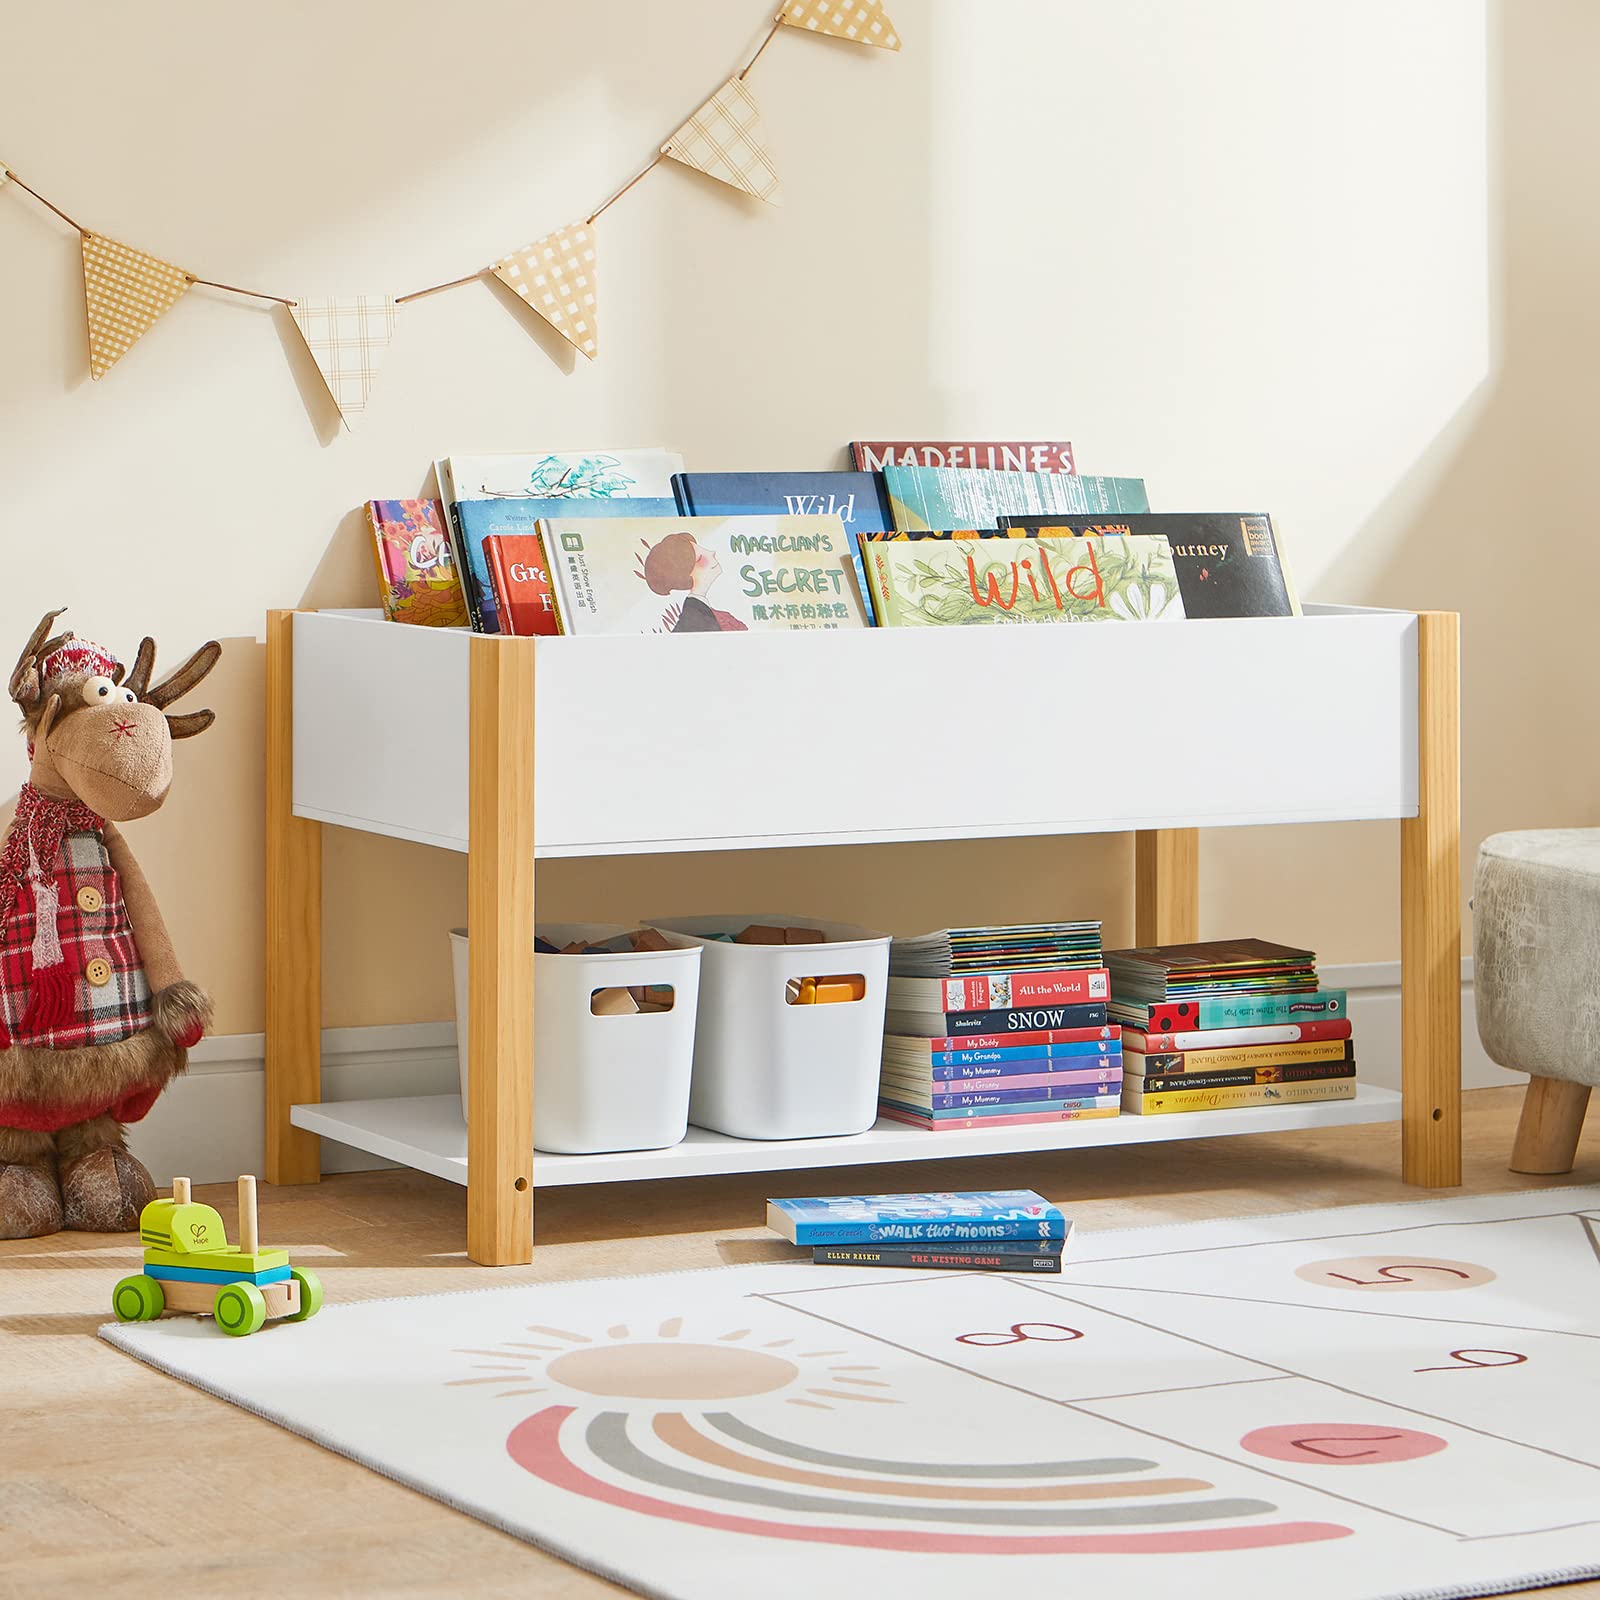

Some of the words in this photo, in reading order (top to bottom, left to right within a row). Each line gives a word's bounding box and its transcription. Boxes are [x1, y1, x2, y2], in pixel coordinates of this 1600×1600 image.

[783, 494, 856, 523] Wild
[489, 523, 514, 531] Carole
[730, 533, 833, 556] MAGICIAN'S
[581, 568, 590, 587] Show
[740, 564, 844, 597] SECRET
[585, 589, 597, 613] English
[752, 602, 849, 621] 魔术师的秘密
[1019, 986, 1035, 996] All
[1037, 984, 1052, 994] the
[1053, 983, 1081, 994] World
[1224, 1008, 1237, 1016] Pigs
[1256, 1006, 1274, 1014] Three
[1007, 1009, 1065, 1030] SNOW
[967, 1039, 978, 1048] My
[979, 1039, 999, 1047] Daddy
[962, 1053, 973, 1062] My
[974, 1052, 1001, 1061] Grandpa
[962, 1068, 974, 1077] My
[975, 1067, 1001, 1076] Mummy
[963, 1083, 974, 1091] My
[962, 1096, 973, 1105] My
[974, 1095, 1001, 1103] Mummy
[1175, 1091, 1221, 1105] Despereaux
[880, 1224, 923, 1239] WALK
[926, 1223, 951, 1237] two
[955, 1224, 1005, 1238] moons
[827, 1252, 851, 1260] ELLEN
[853, 1253, 881, 1261] RASKIN
[911, 1255, 928, 1263] THE
[930, 1255, 971, 1264] WESTING
[974, 1257, 1001, 1265] GAME
